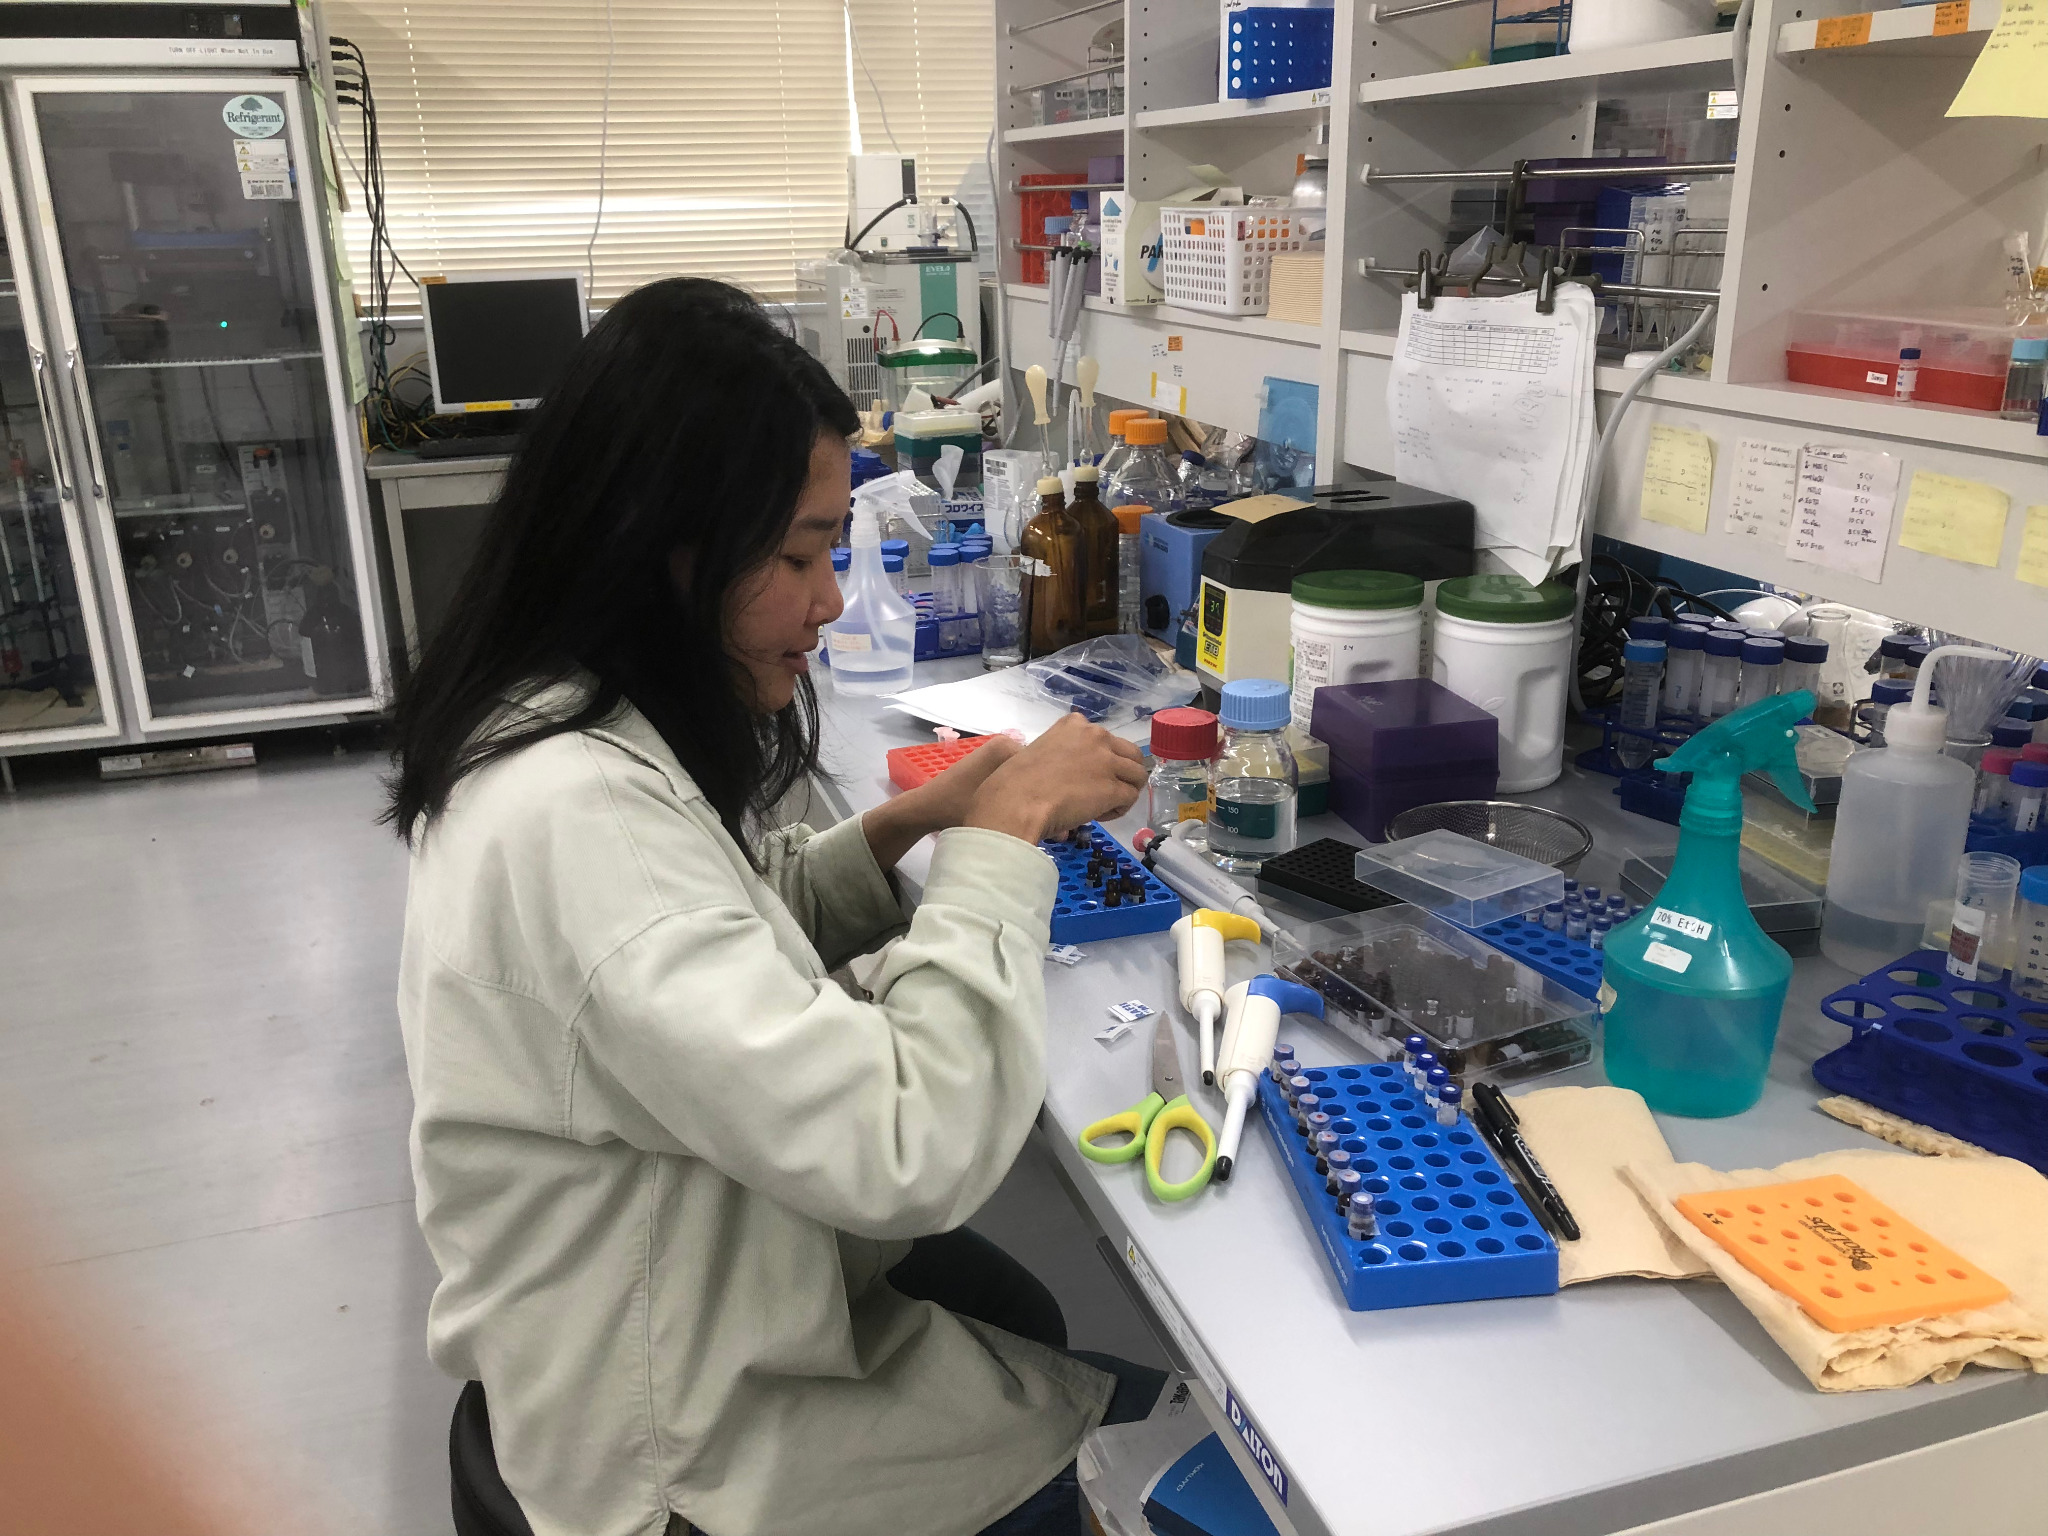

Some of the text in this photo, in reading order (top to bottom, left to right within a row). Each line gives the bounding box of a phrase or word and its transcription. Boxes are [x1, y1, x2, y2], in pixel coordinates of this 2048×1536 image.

[226, 111, 282, 125] Refrigerant
[1227, 806, 1239, 815] 150
[1227, 826, 1239, 834] 100
[1656, 911, 1673, 925] 70%
[1811, 1215, 1878, 1260] BioLabs
[1231, 1398, 1283, 1496] DALTON
[1176, 1462, 1205, 1492] KOKUYO
